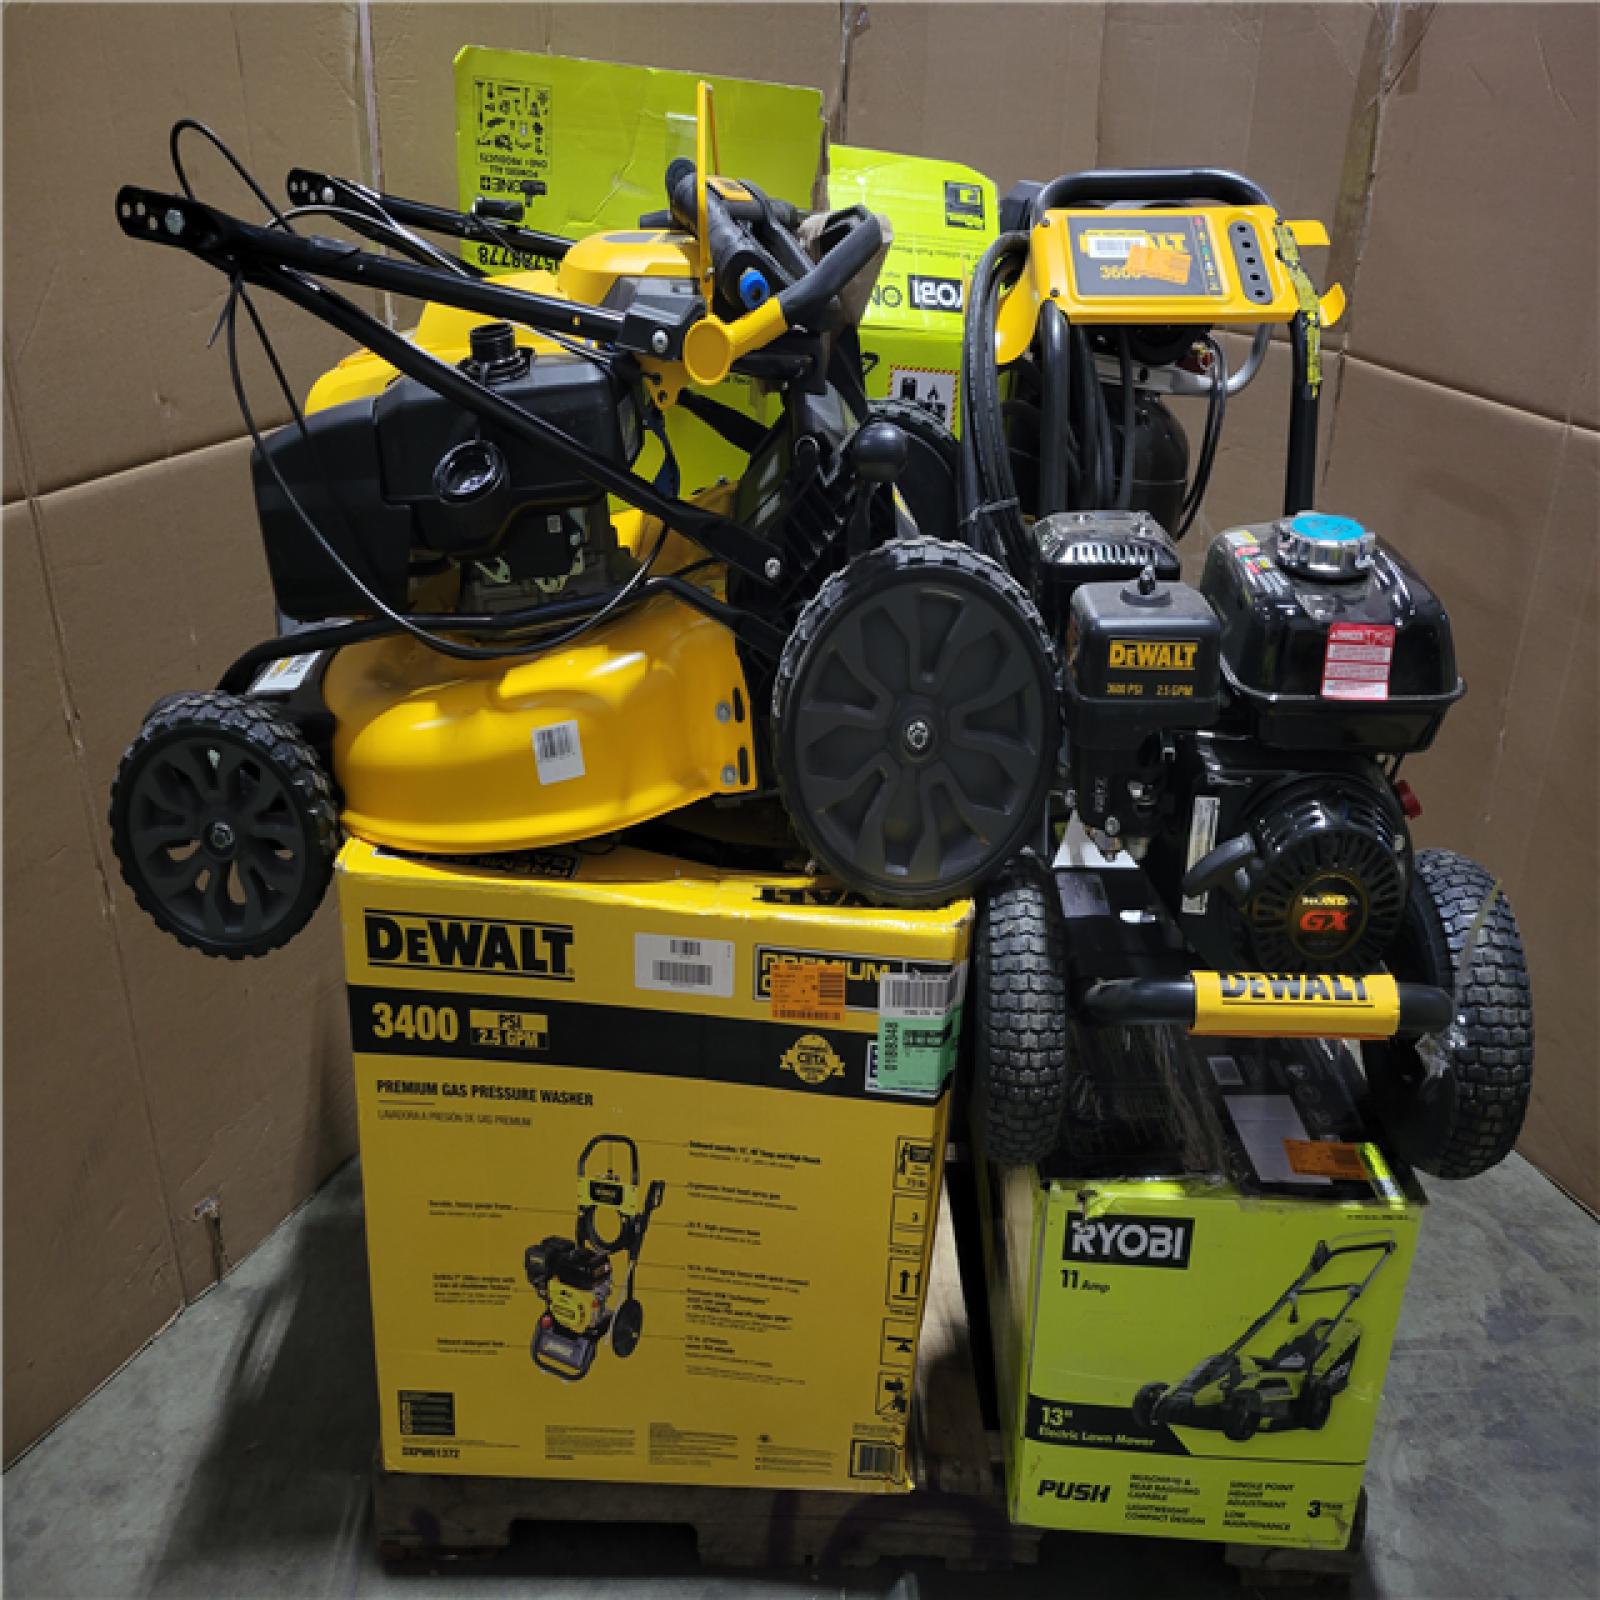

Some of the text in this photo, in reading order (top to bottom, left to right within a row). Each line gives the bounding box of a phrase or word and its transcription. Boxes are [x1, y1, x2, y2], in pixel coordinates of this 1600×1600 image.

[1299, 909, 1350, 931] GX
[371, 1001, 459, 1043] 3400
[500, 1013, 521, 1030] PSI
[480, 1028, 538, 1049] 2.5 GPM
[376, 1079, 594, 1107] PREMIUM GAS PRESSURE WASHER
[1071, 1219, 1186, 1261] RYOBI
[1060, 1269, 1111, 1294] 11 Amp
[1041, 1404, 1073, 1427] 13"
[1037, 1478, 1112, 1504] PUSH
[1264, 1482, 1295, 1492] POINT
[1125, 1511, 1206, 1526] COMPACT DESIGN
[1224, 1510, 1246, 1519] LOW
[1306, 1499, 1321, 1518] 3
[1222, 1519, 1291, 1531] MAINTENANCE
